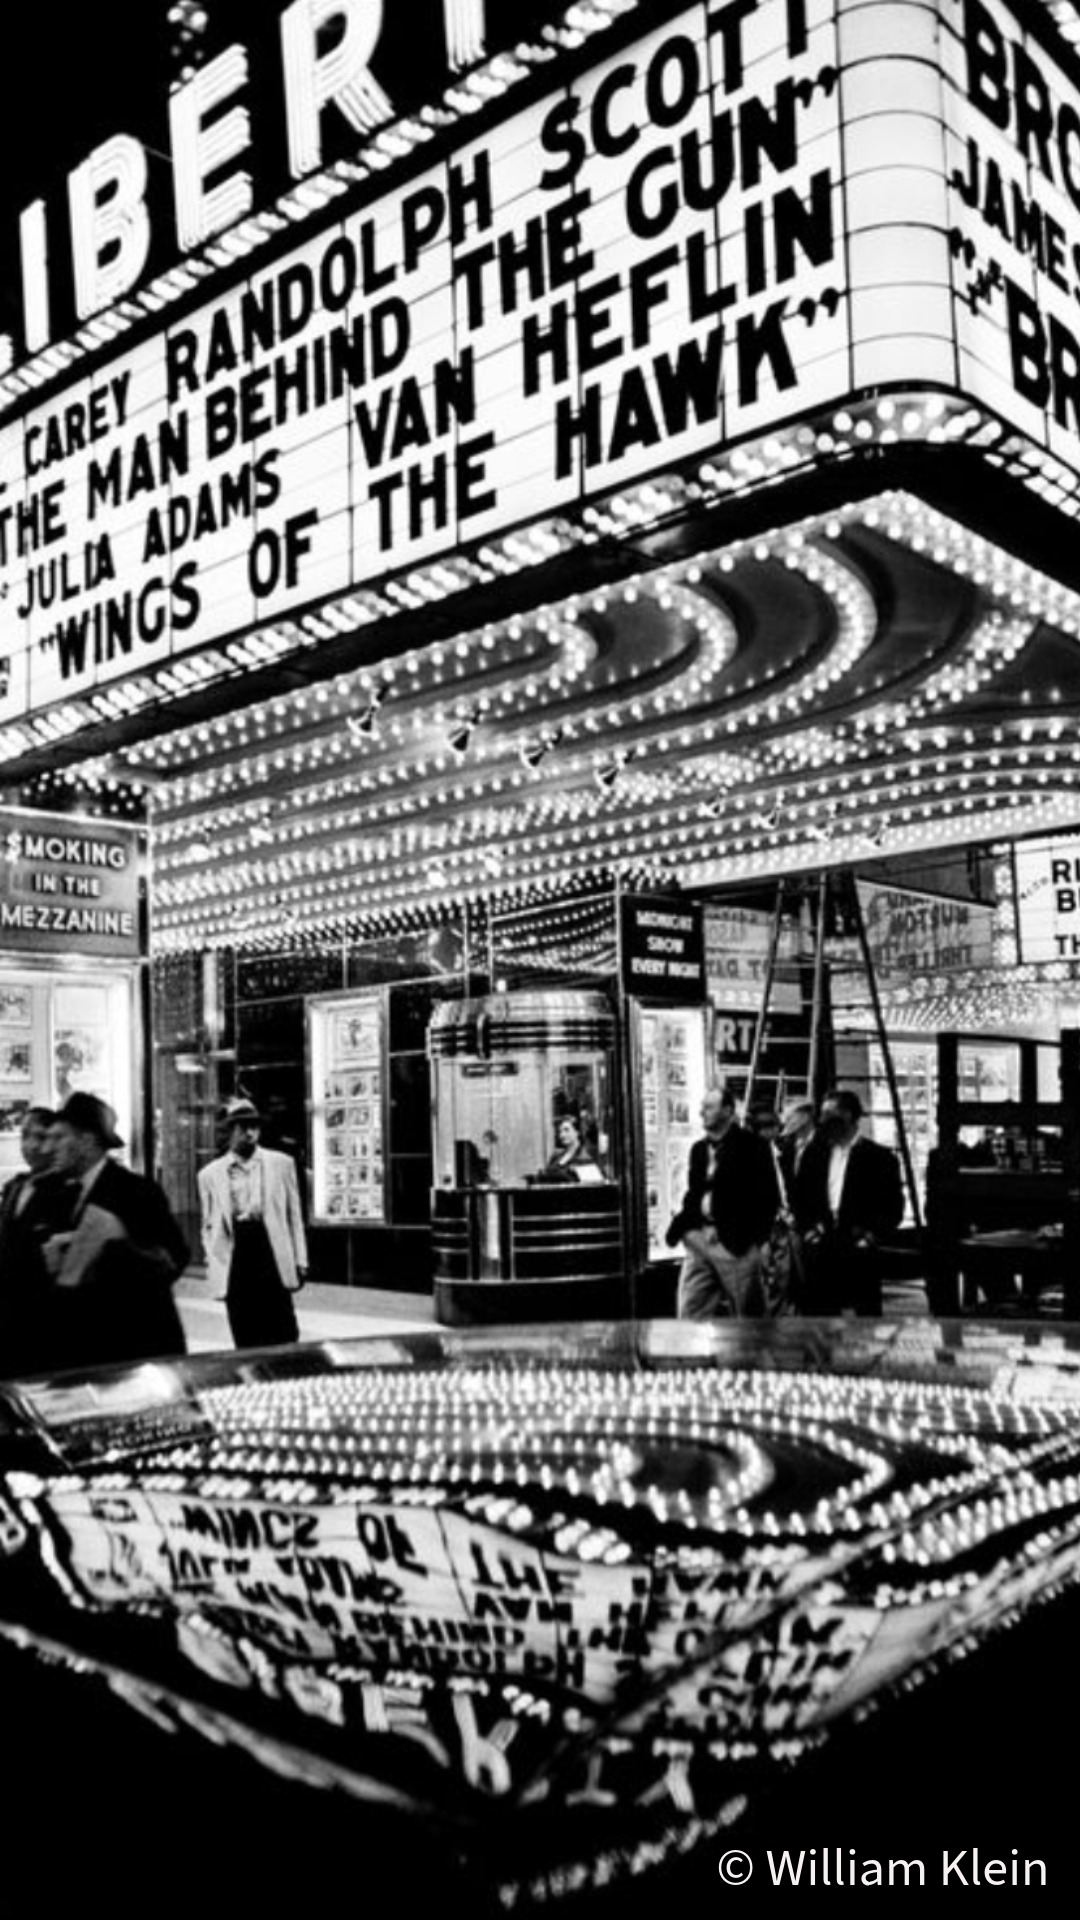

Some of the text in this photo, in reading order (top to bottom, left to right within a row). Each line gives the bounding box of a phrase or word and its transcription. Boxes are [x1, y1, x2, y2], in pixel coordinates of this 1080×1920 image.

[0, 0, 486, 376] IBER
[17, 167, 834, 619] JULIA ADAMS VAN HEFLIN
[25, 369, 131, 477] CAREY
[165, 148, 494, 405] RANDOLPH
[88, 409, 189, 520] MAN
[205, 296, 411, 461] BEHIND
[453, 188, 595, 331] THE
[248, 507, 319, 600] OF
[368, 430, 497, 552] THE
[1, 902, 133, 936] MEZZANINE
[32, 873, 101, 898] IN THE
[631, 956, 667, 975] EVERY
[646, 934, 685, 954] SHOW
